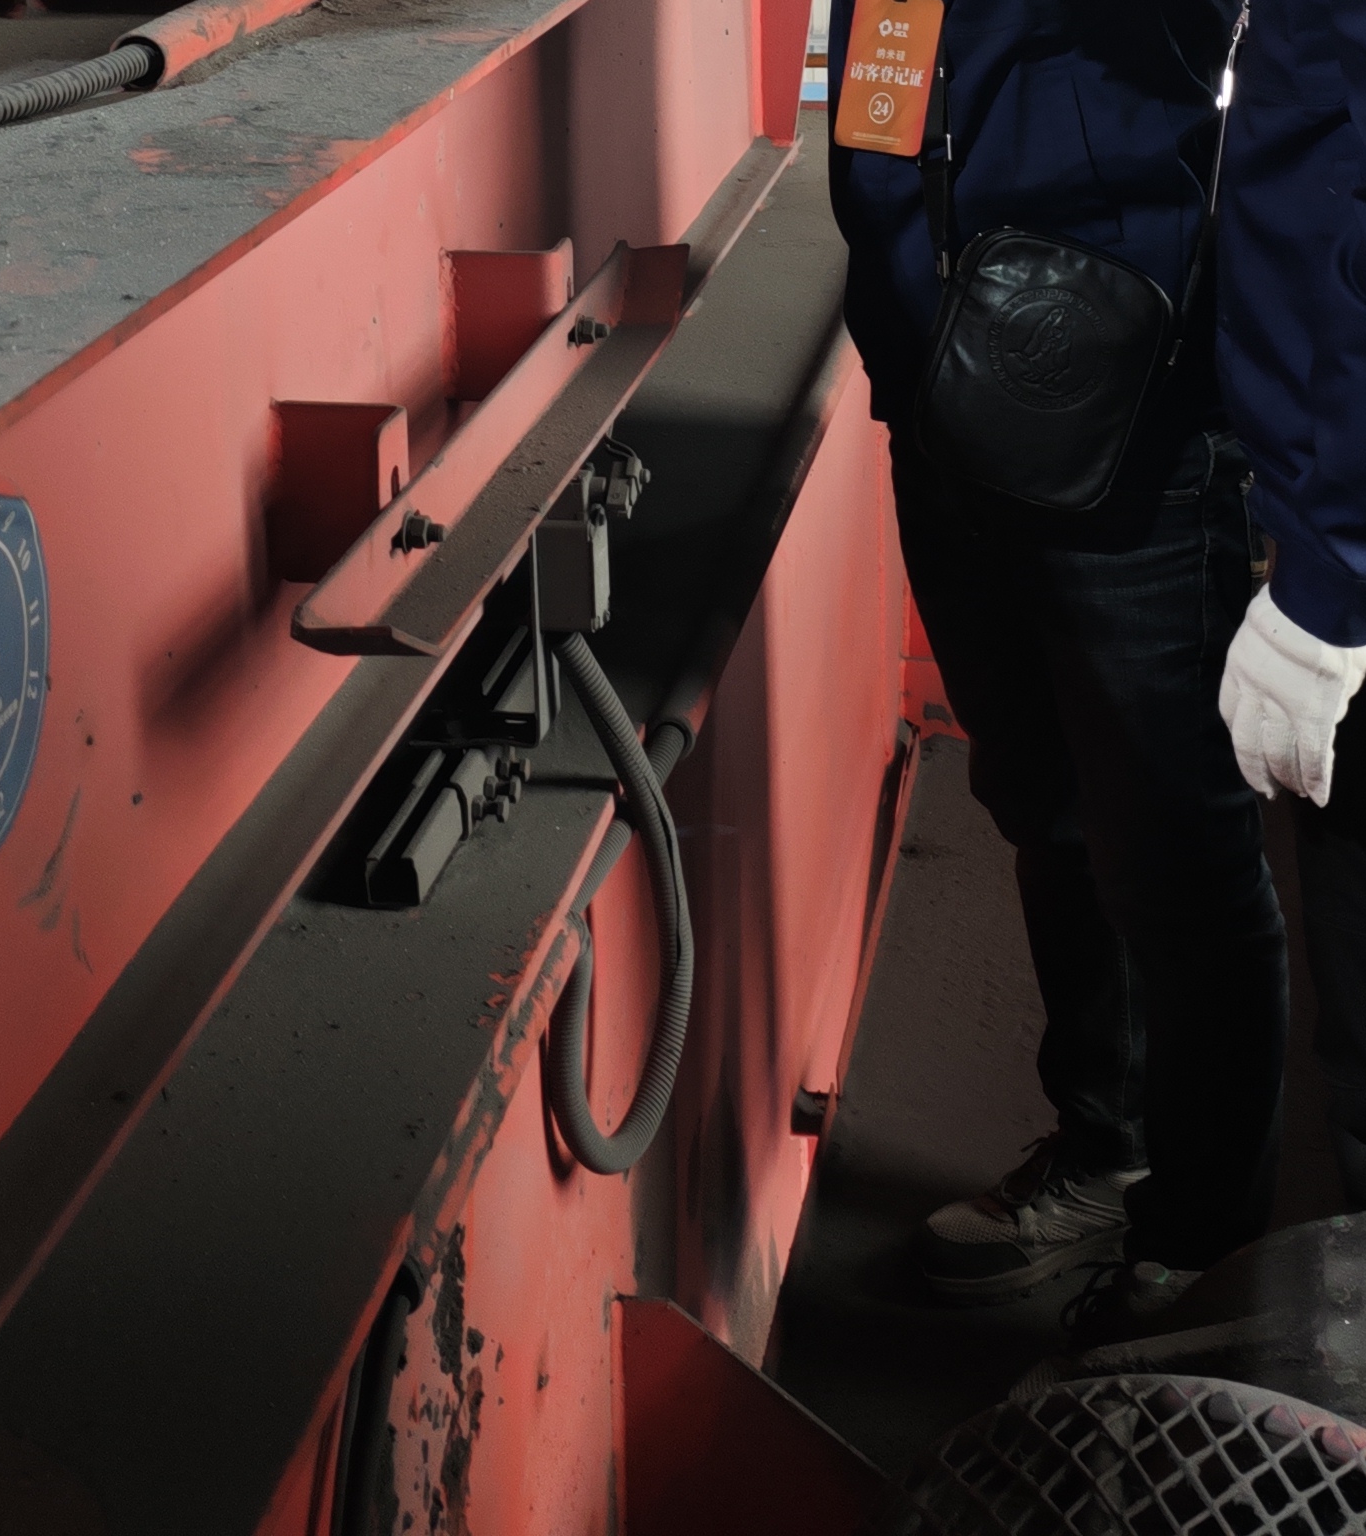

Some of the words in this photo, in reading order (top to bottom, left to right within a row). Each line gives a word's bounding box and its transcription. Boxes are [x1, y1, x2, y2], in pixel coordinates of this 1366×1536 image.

[850, 61, 925, 88] 访客登记证
[873, 100, 889, 117] 24
[17, 538, 31, 572] 10
[29, 599, 40, 628] 11
